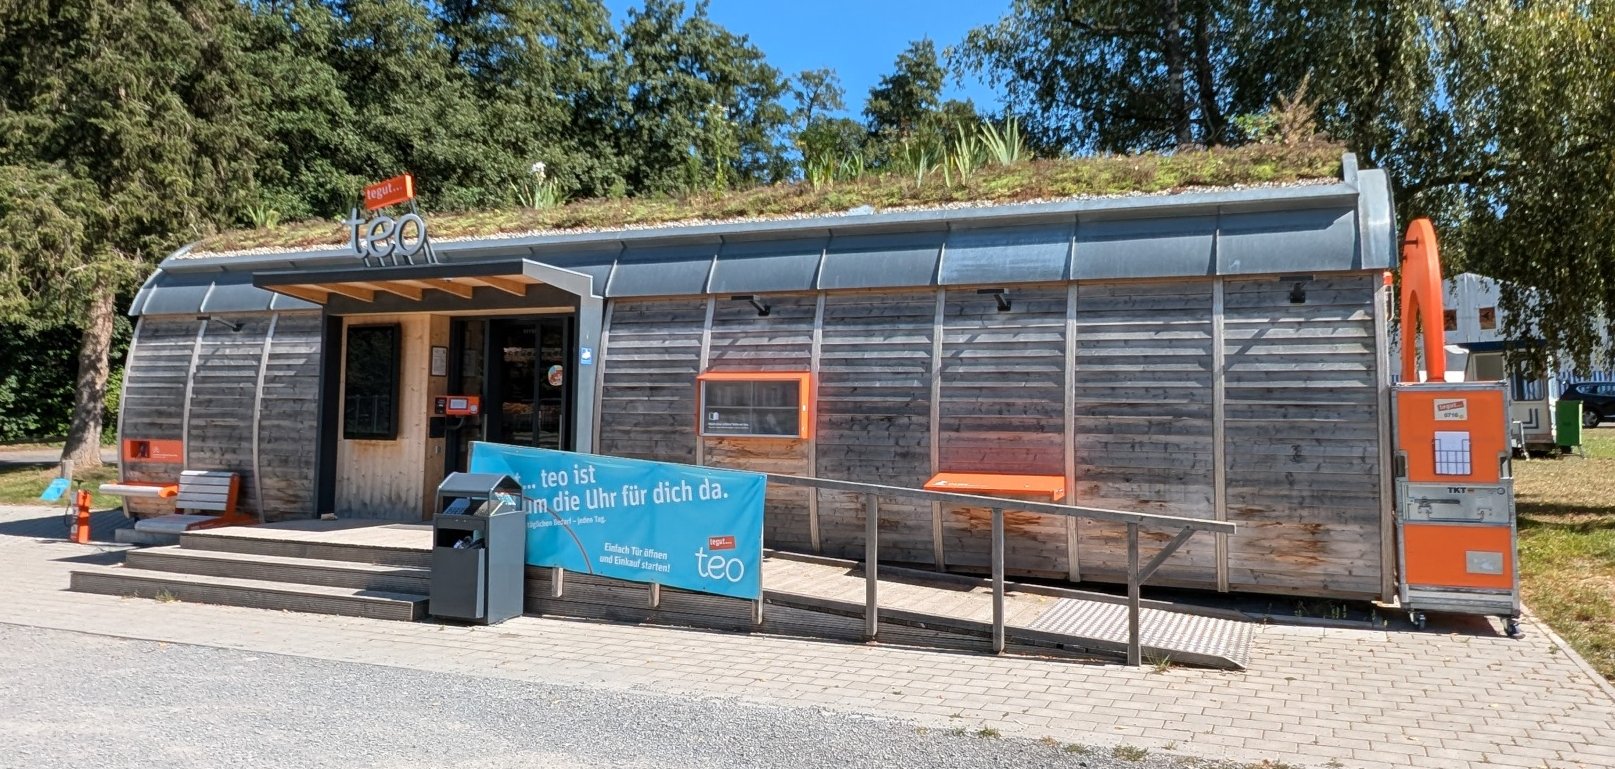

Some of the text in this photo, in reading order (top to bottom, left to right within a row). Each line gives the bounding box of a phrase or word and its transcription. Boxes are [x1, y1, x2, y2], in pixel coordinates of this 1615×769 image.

[366, 183, 402, 200] tegut...
[346, 208, 425, 259] teo
[541, 469, 568, 488] teo
[573, 464, 596, 484] ist
[553, 490, 580, 512] die
[586, 487, 617, 510] Uhr
[622, 484, 647, 507] für
[653, 479, 693, 504] dich
[699, 478, 728, 500] da.
[604, 542, 668, 560] Einfach Tür öffnen
[709, 537, 733, 547] tegut...
[599, 554, 671, 573] und Einkauf starten!
[694, 547, 745, 582] teo
